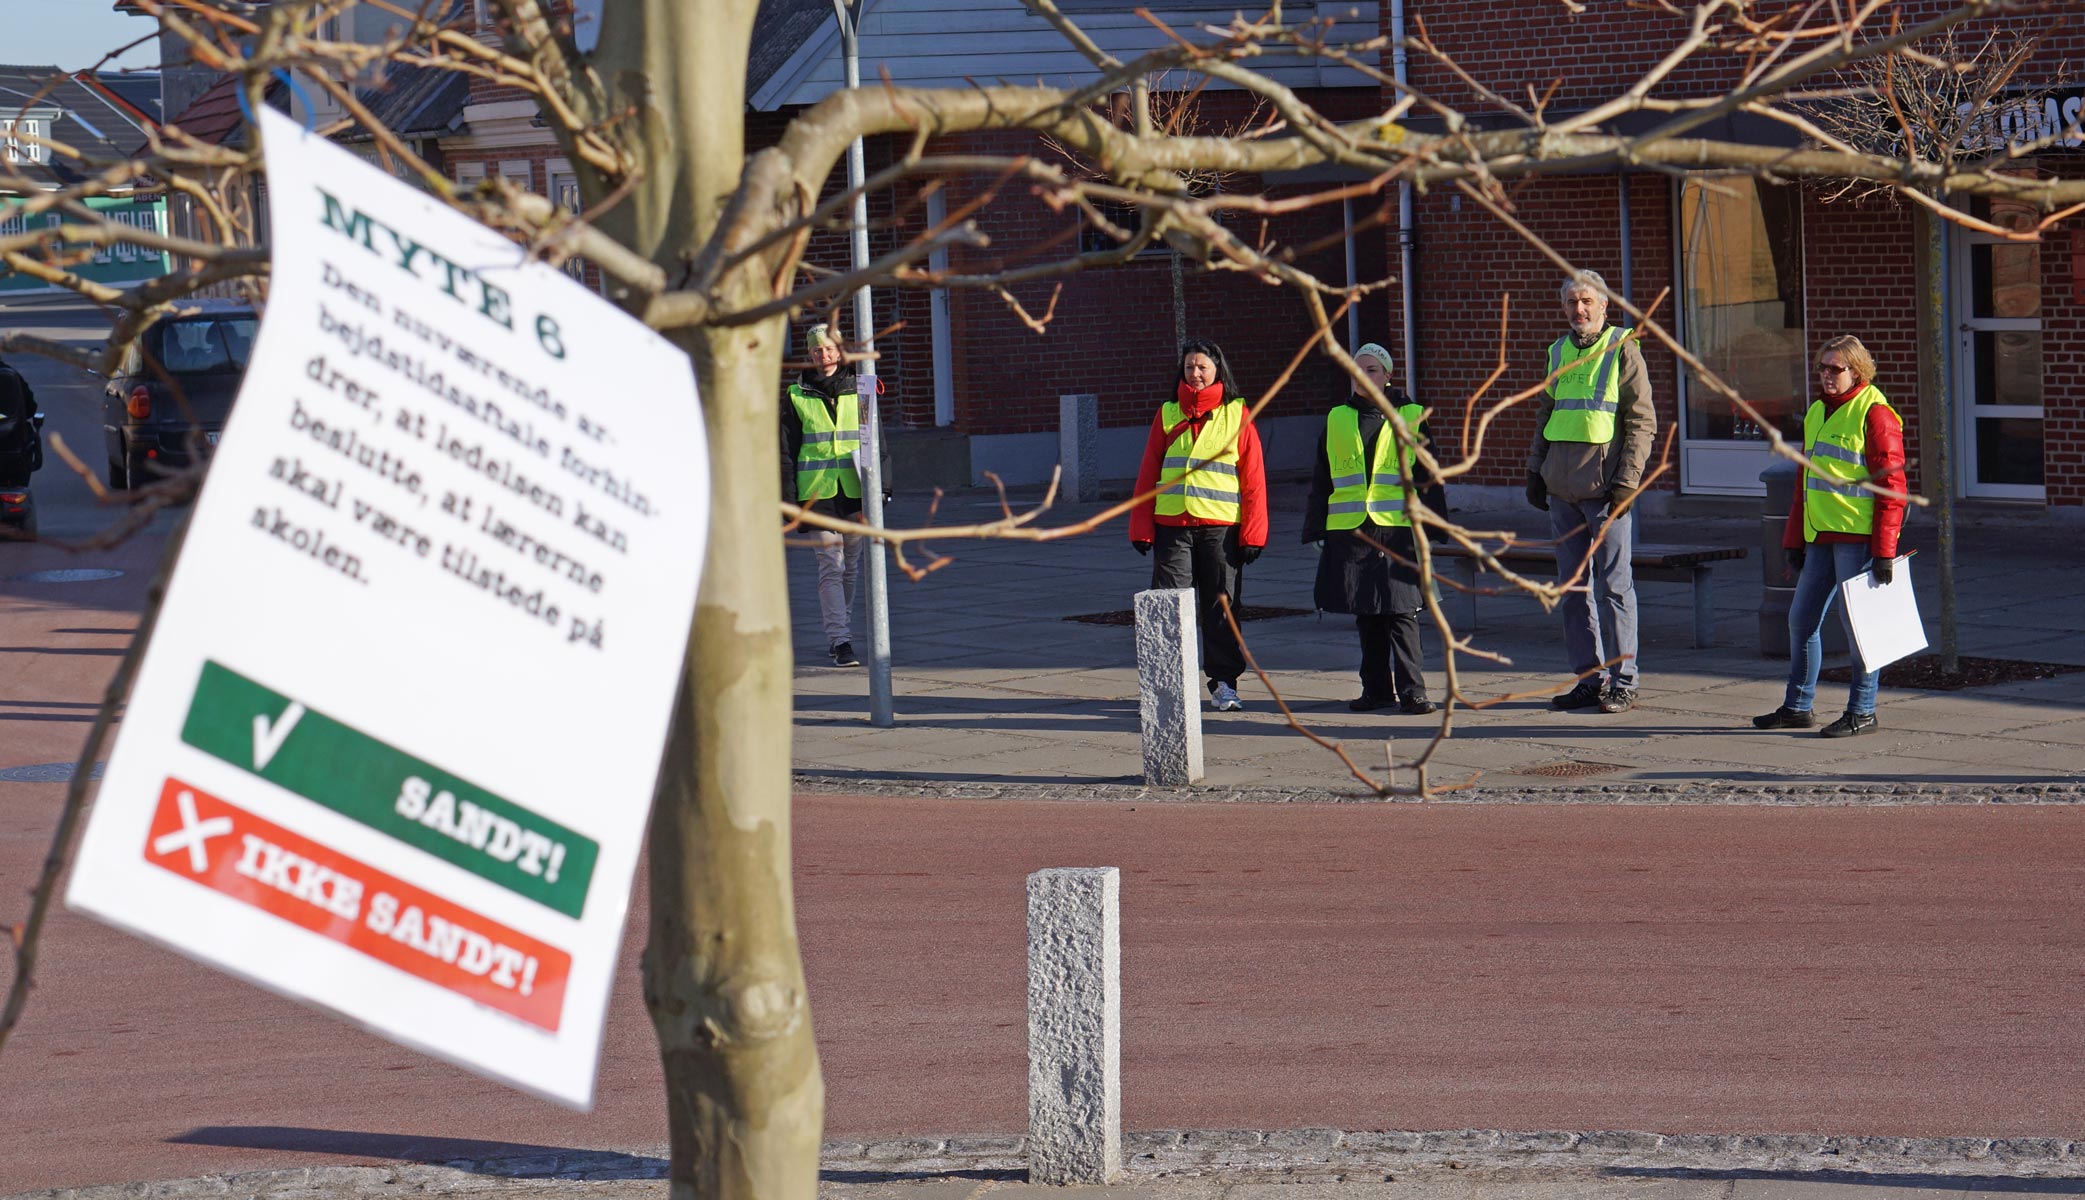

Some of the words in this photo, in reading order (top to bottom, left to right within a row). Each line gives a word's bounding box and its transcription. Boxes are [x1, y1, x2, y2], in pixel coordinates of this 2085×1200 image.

[315, 184, 515, 332] MYTE
[534, 313, 566, 361] 6
[321, 260, 382, 316] Den
[393, 304, 567, 421] nuværende
[577, 414, 619, 447] ar-
[289, 399, 430, 508] beslutte,
[440, 489, 473, 524] at
[480, 505, 605, 594] lærerne
[306, 354, 383, 425] drer,
[397, 405, 427, 440] at
[434, 423, 565, 519] ledelsen
[572, 500, 630, 557] kan
[318, 303, 551, 460] bejdstidsaftale
[560, 445, 660, 518] forhin-
[250, 505, 371, 588] skolen.
[268, 454, 344, 512] skal
[352, 498, 432, 558] være
[439, 543, 561, 627] tilstede
[566, 614, 605, 652] på
[234, 832, 366, 922] IKKE
[366, 891, 539, 997] SANDT!
[394, 774, 568, 885] SANDT!
